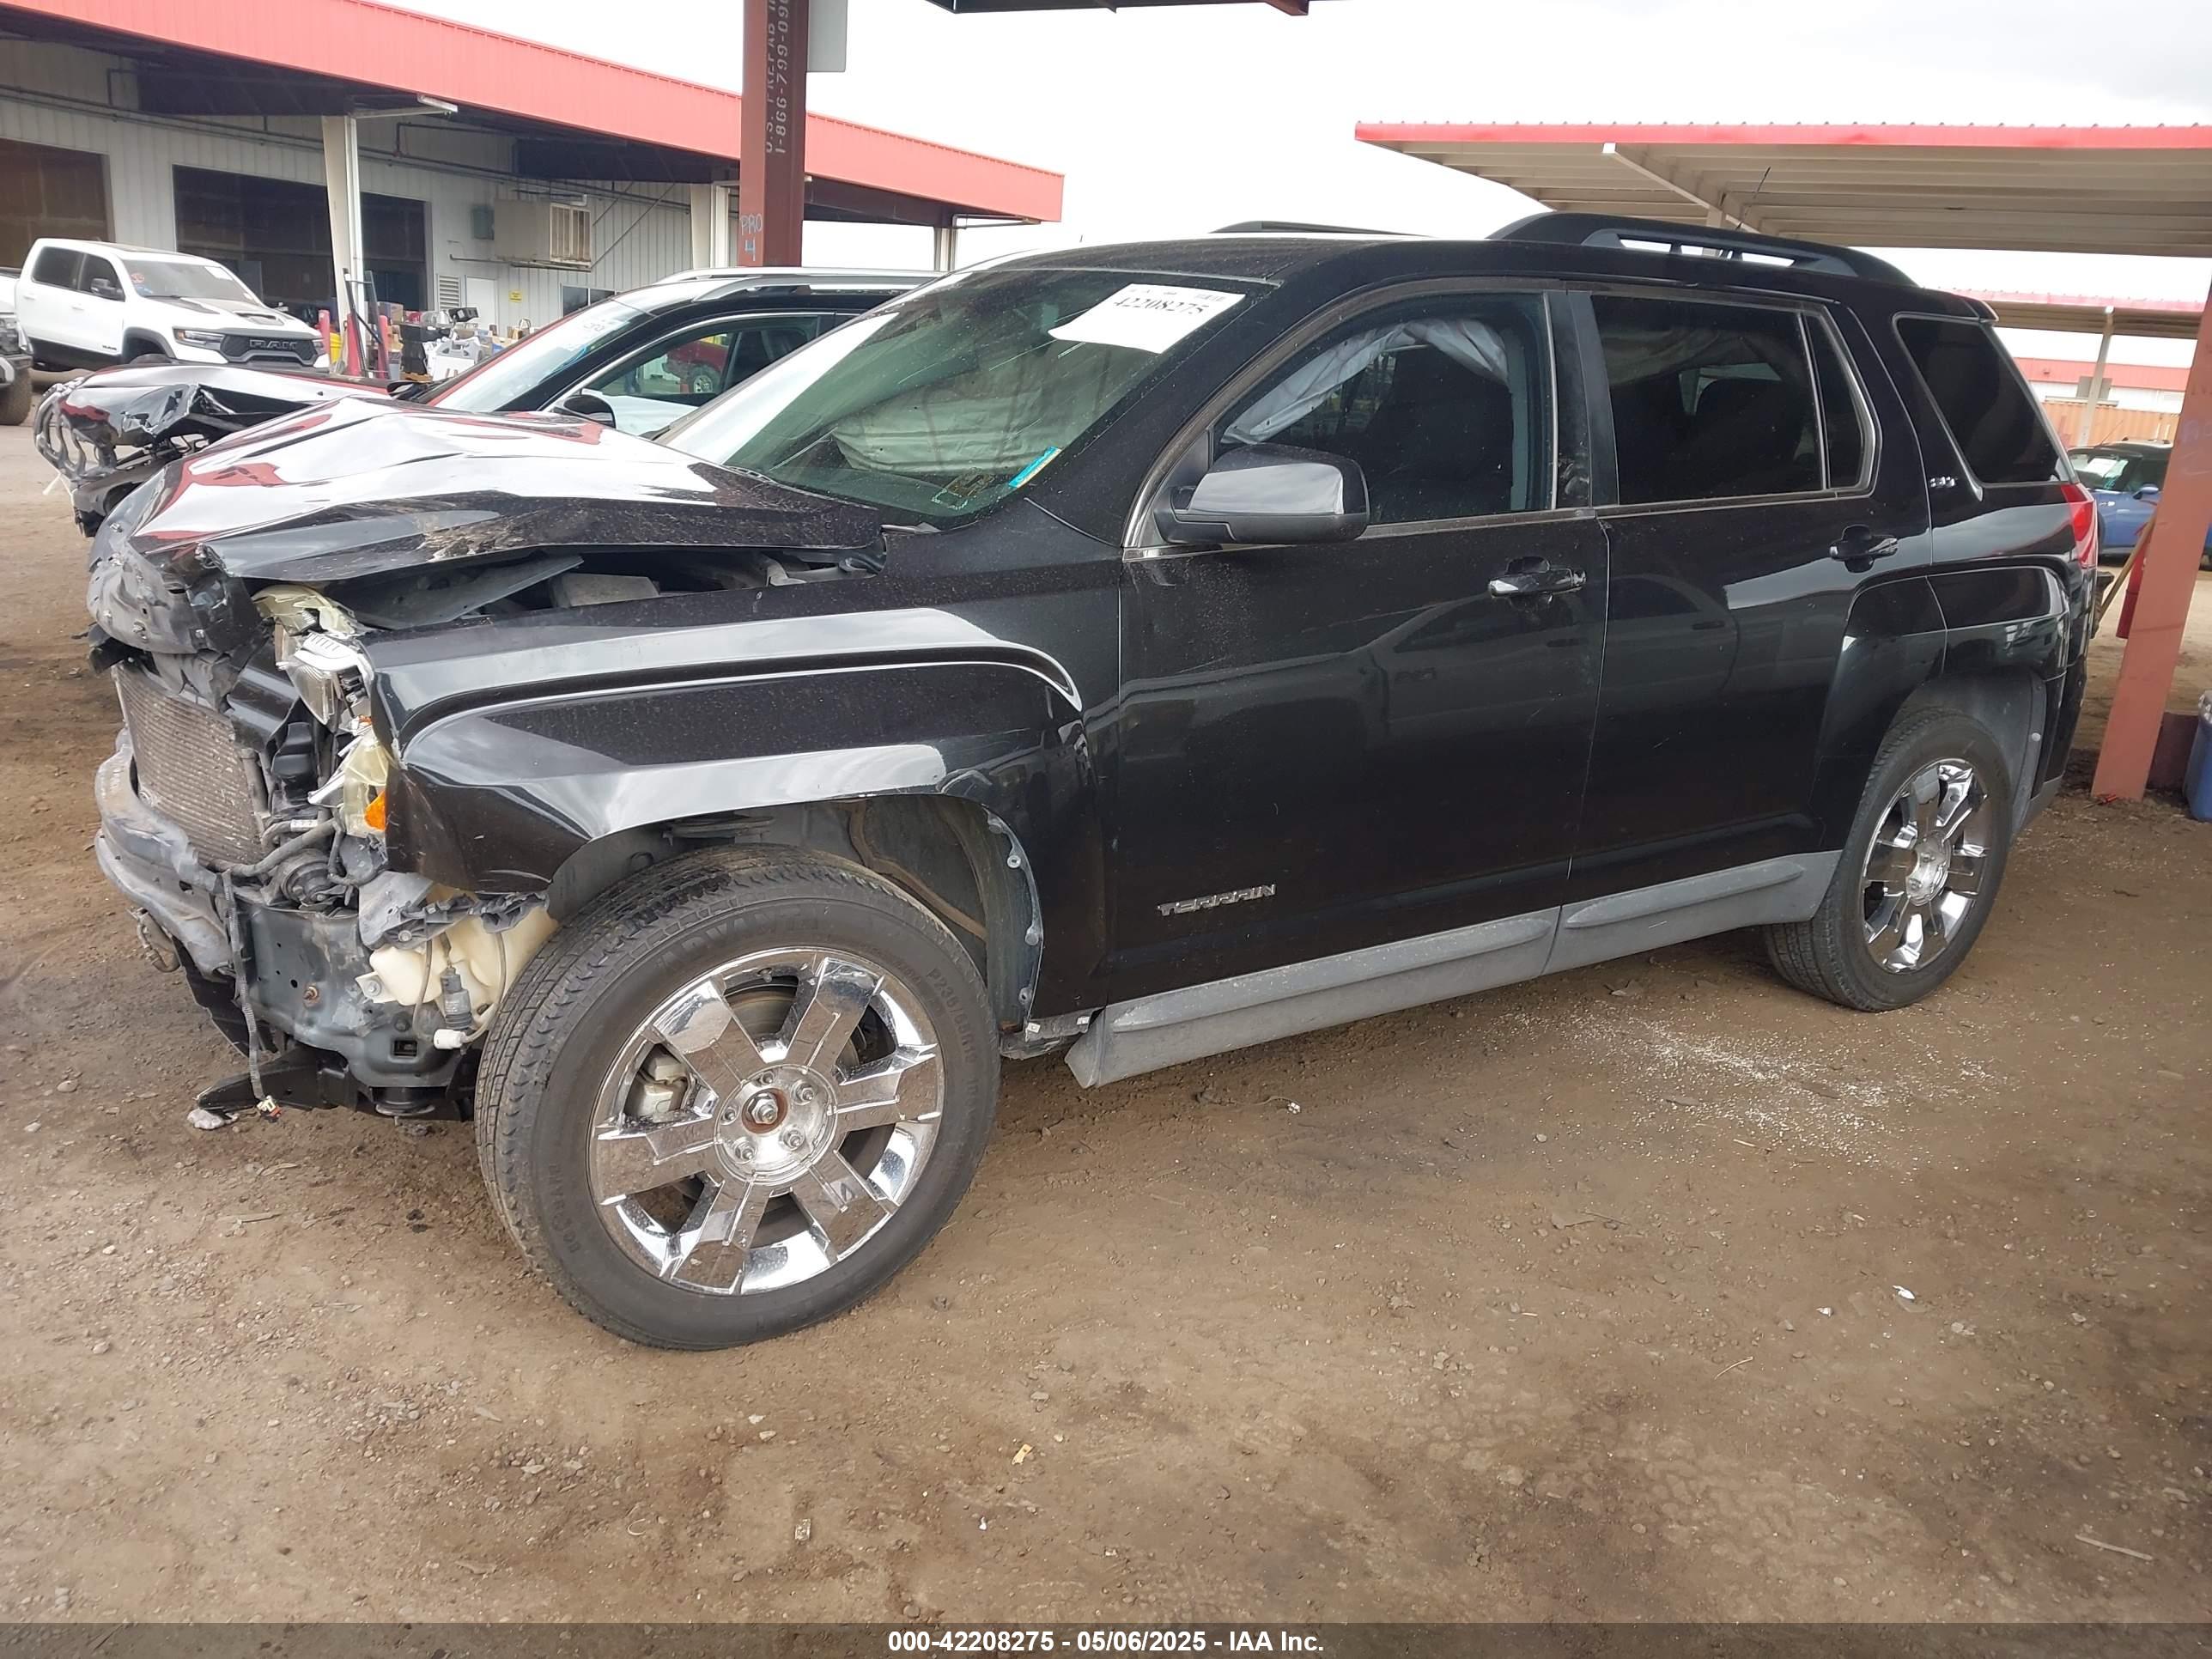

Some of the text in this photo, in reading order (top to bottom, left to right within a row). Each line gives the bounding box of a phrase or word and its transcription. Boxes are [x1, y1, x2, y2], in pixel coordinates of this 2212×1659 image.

[744, 236, 756, 261] 4
[1114, 297, 1210, 315] 42208275
[249, 338, 297, 351] RAM
[1158, 884, 1276, 916] TERRAIN
